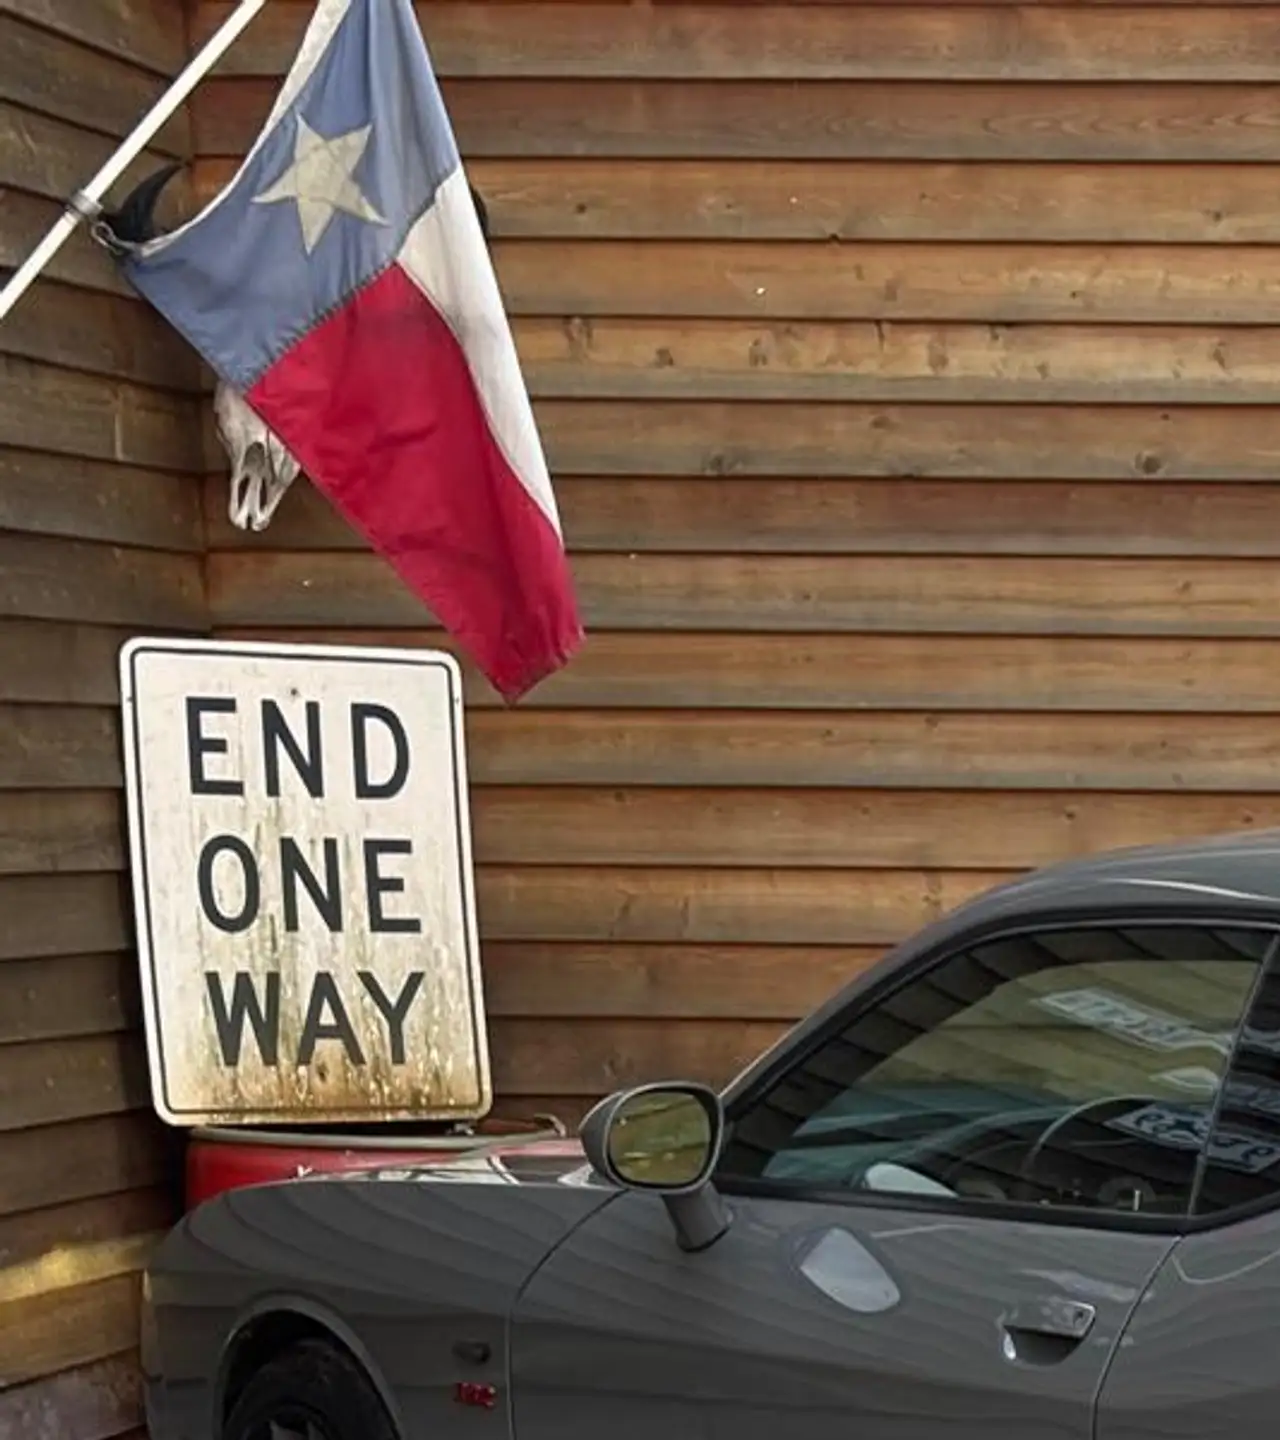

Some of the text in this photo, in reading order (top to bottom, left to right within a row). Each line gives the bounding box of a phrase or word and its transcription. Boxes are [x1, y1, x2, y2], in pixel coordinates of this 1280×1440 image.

[185, 696, 410, 799] END
[197, 835, 421, 934] ONE
[205, 971, 425, 1067] WAY
